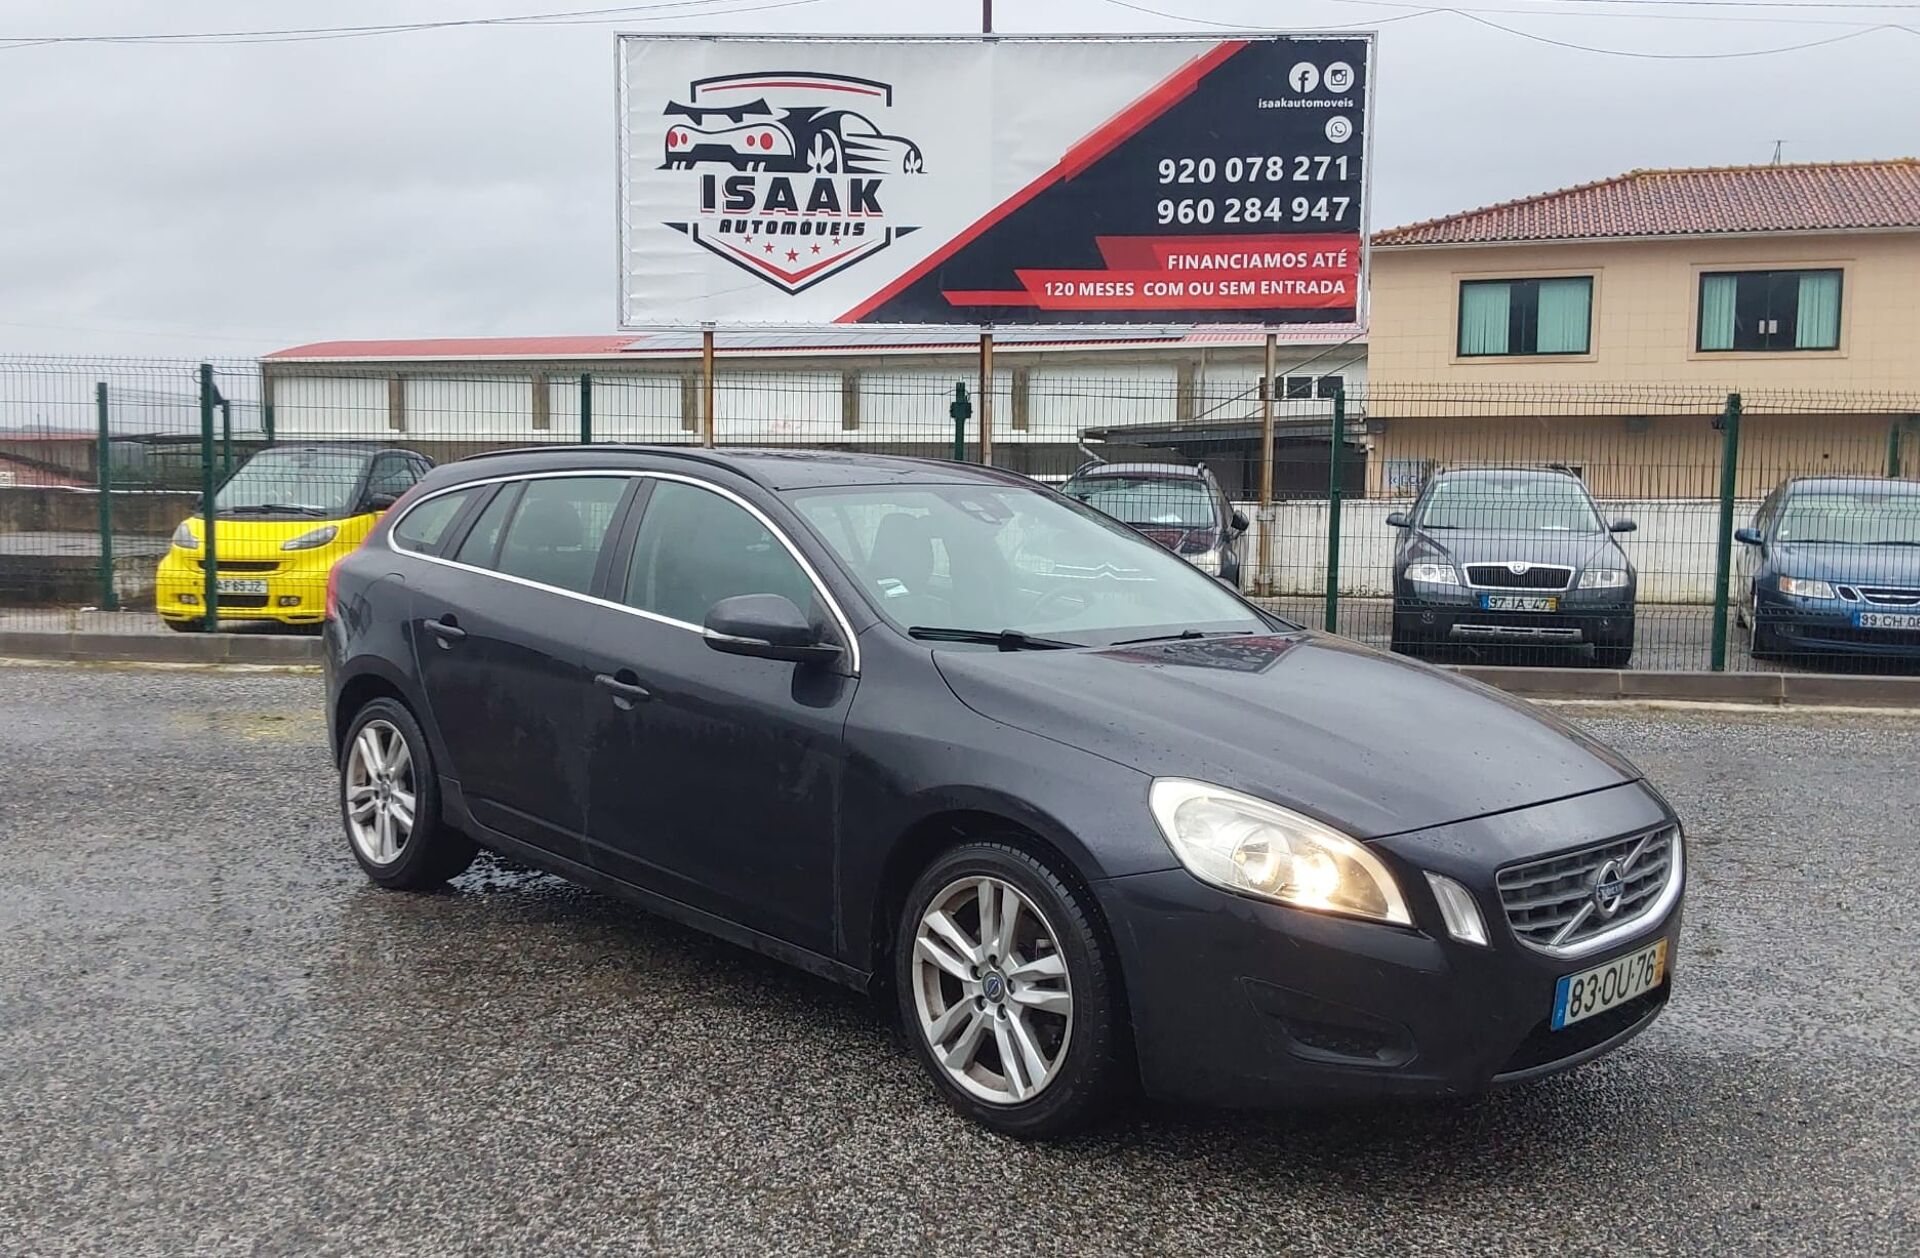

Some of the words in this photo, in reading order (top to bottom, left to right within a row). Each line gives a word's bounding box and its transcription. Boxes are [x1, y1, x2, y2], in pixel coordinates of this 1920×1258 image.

[1258, 97, 1354, 109] isaakautomoveis
[1158, 158, 1216, 184] 920
[1225, 156, 1284, 183] 078
[1292, 155, 1348, 181] 271
[701, 174, 884, 217] ISAAK
[1157, 199, 1215, 224] 960
[1224, 197, 1282, 223] 284
[1291, 197, 1350, 222] 947
[719, 219, 866, 236] AUTOMÓVEIS
[1167, 252, 1308, 270] FINANCIAMOS
[1311, 248, 1348, 268] ATÉ
[1044, 282, 1075, 296] 120
[1079, 282, 1134, 296] MESES
[1143, 282, 1184, 296] COM
[1188, 282, 1214, 296] OU
[1219, 281, 1256, 295] SEM
[1260, 280, 1346, 295] ENTRADA
